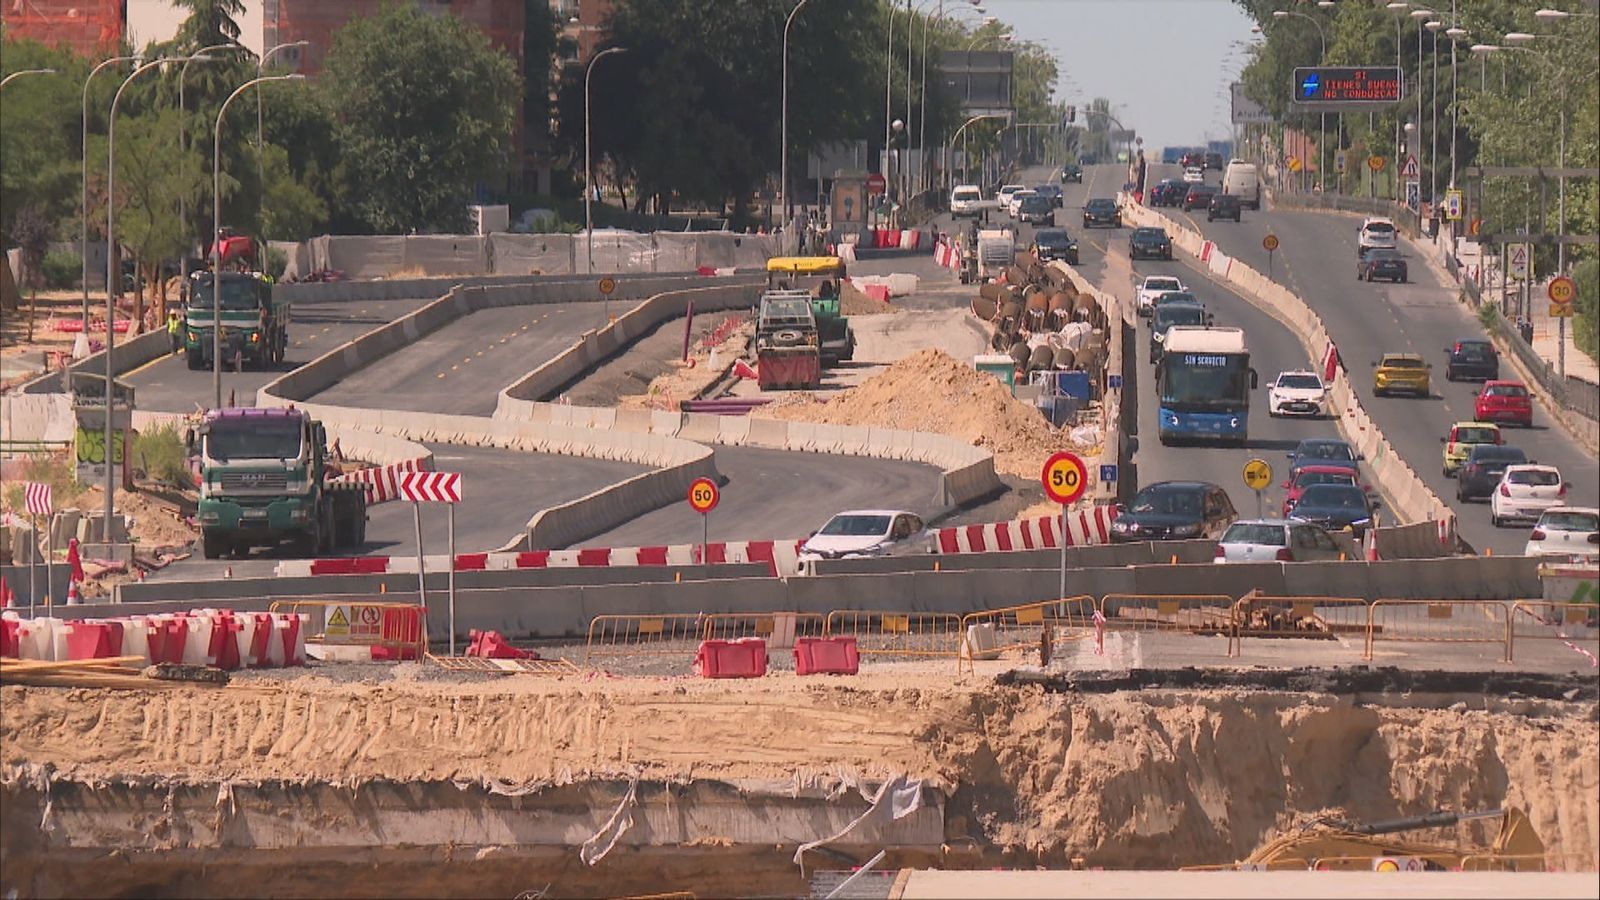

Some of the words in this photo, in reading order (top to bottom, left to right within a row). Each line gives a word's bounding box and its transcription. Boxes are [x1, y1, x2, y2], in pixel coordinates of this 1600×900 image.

[1355, 71, 1366, 79] SI
[1325, 80, 1361, 89] TIENES
[1324, 89, 1337, 98] NO
[1343, 89, 1398, 98] CONDUZCAS
[1555, 286, 1570, 296] 30
[1184, 355, 1196, 365] SIN
[1197, 356, 1227, 366] SERVICIO
[1053, 469, 1078, 487] 50
[694, 489, 712, 502] 50
